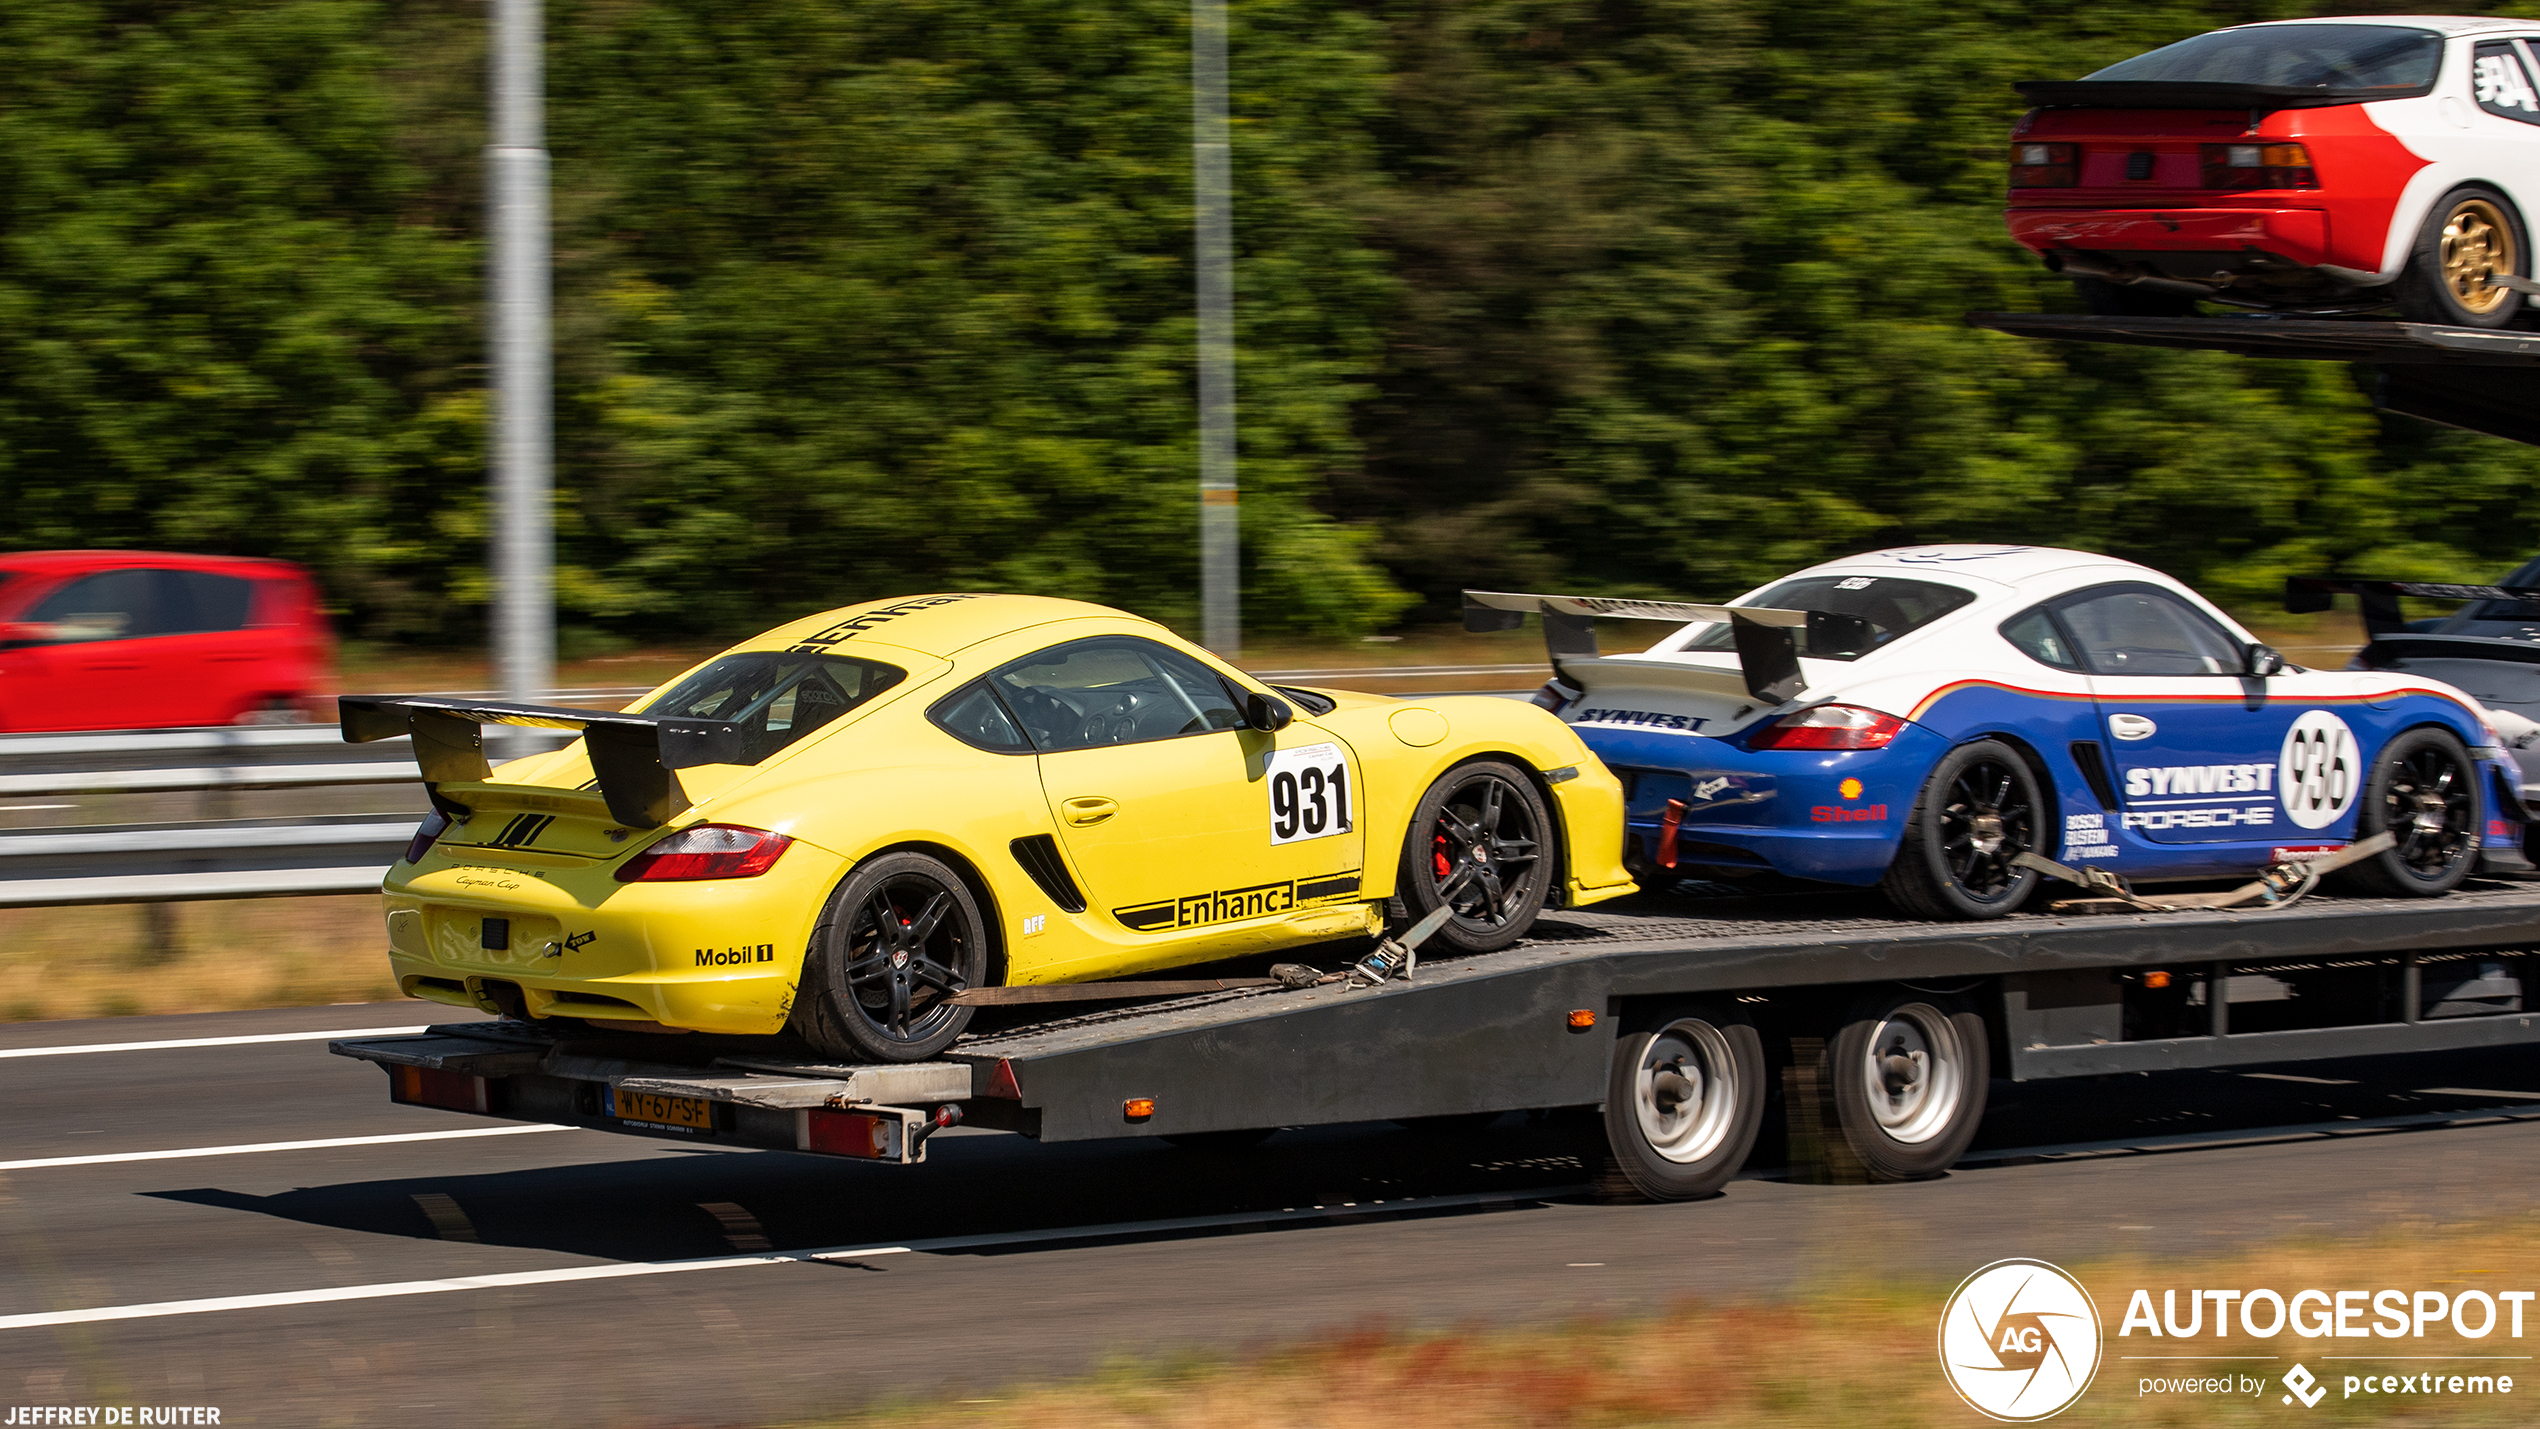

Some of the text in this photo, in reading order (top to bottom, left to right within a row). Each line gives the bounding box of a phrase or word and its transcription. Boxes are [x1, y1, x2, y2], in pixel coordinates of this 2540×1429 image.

[1577, 708, 1712, 732] SYNVEST
[2124, 763, 2276, 797] SYNVEST
[2289, 728, 2348, 811] 936
[1272, 764, 1347, 839] 931
[1811, 804, 1887, 822] Shell
[2121, 807, 2275, 830] PORSCHE
[451, 863, 546, 878] PORSCHE
[456, 876, 521, 890] Cayman Cup
[570, 933, 592, 947] TOW
[695, 945, 752, 967] Mobil
[621, 1091, 704, 1123] WY-67-SF
